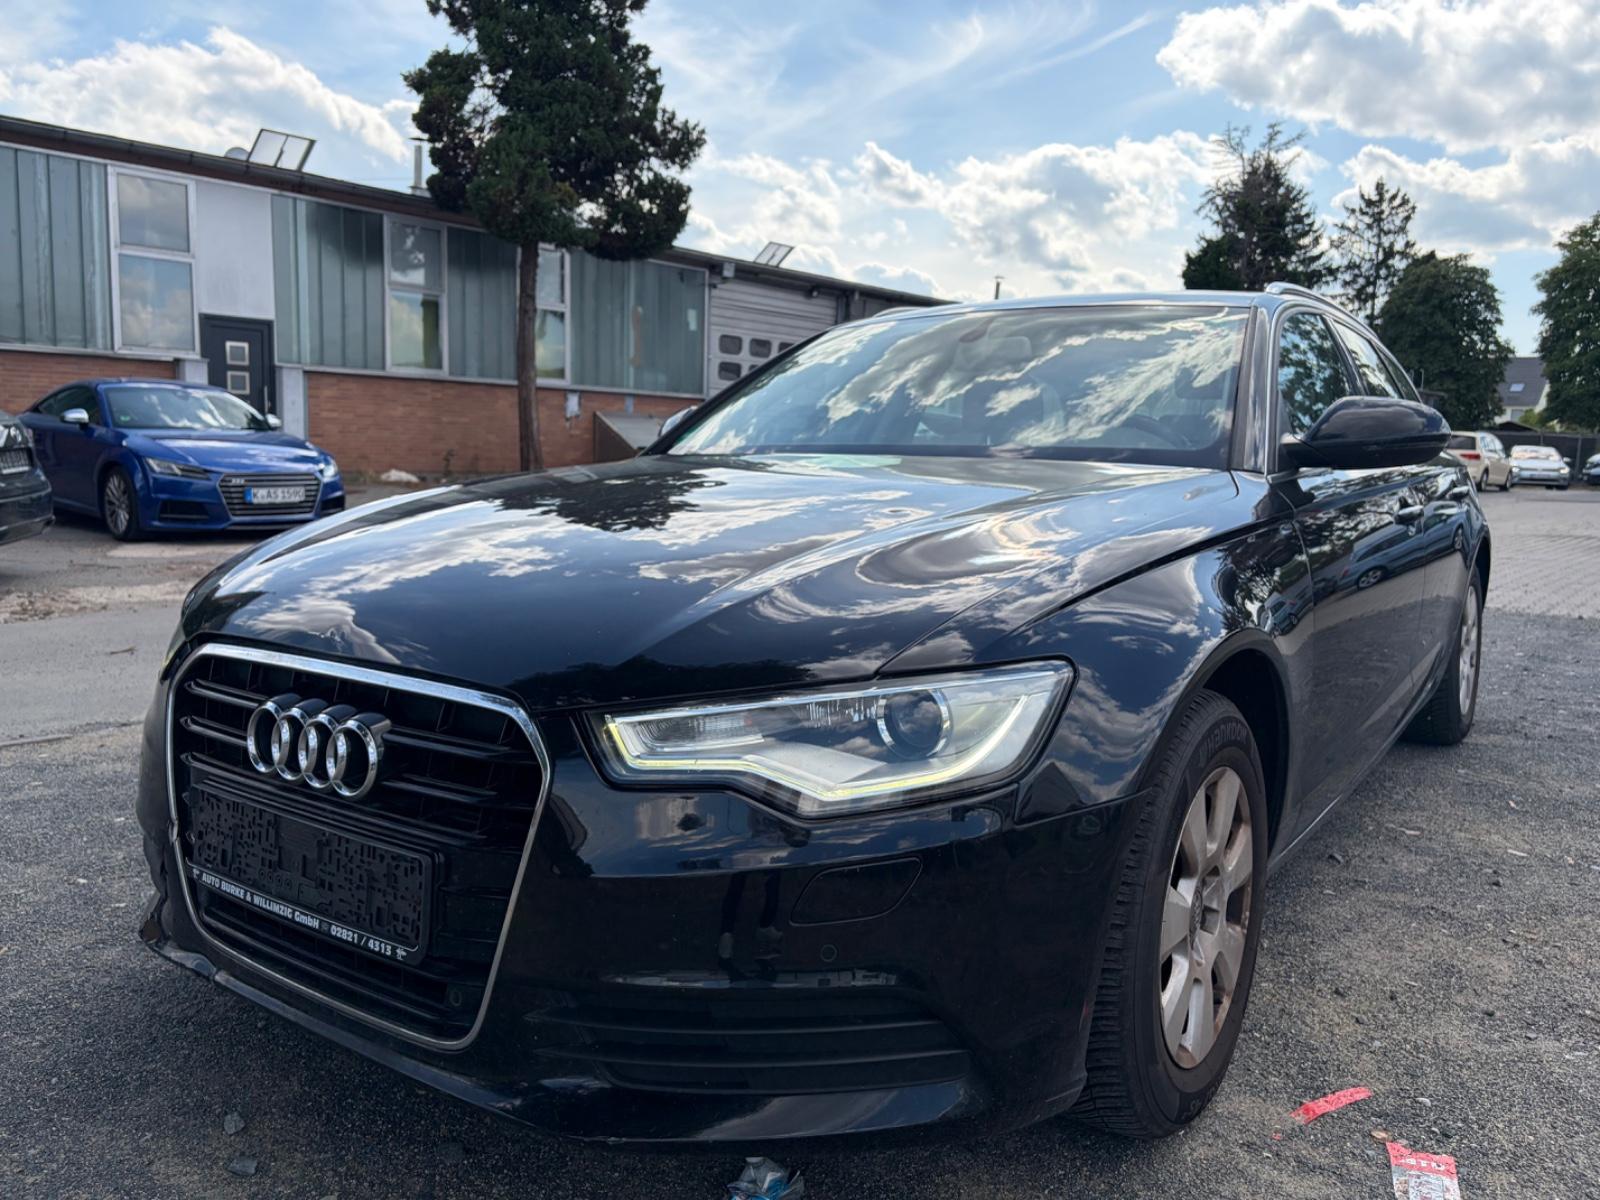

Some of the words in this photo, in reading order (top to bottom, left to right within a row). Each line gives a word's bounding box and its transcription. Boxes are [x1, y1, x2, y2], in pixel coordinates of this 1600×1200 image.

[202, 872, 220, 888] AUTO
[221, 880, 245, 900] BURKE
[246, 891, 252, 903] &
[253, 894, 293, 919] WILLIMZIG
[294, 911, 320, 929] GmbH
[330, 924, 358, 944] 02821
[360, 936, 367, 946] /
